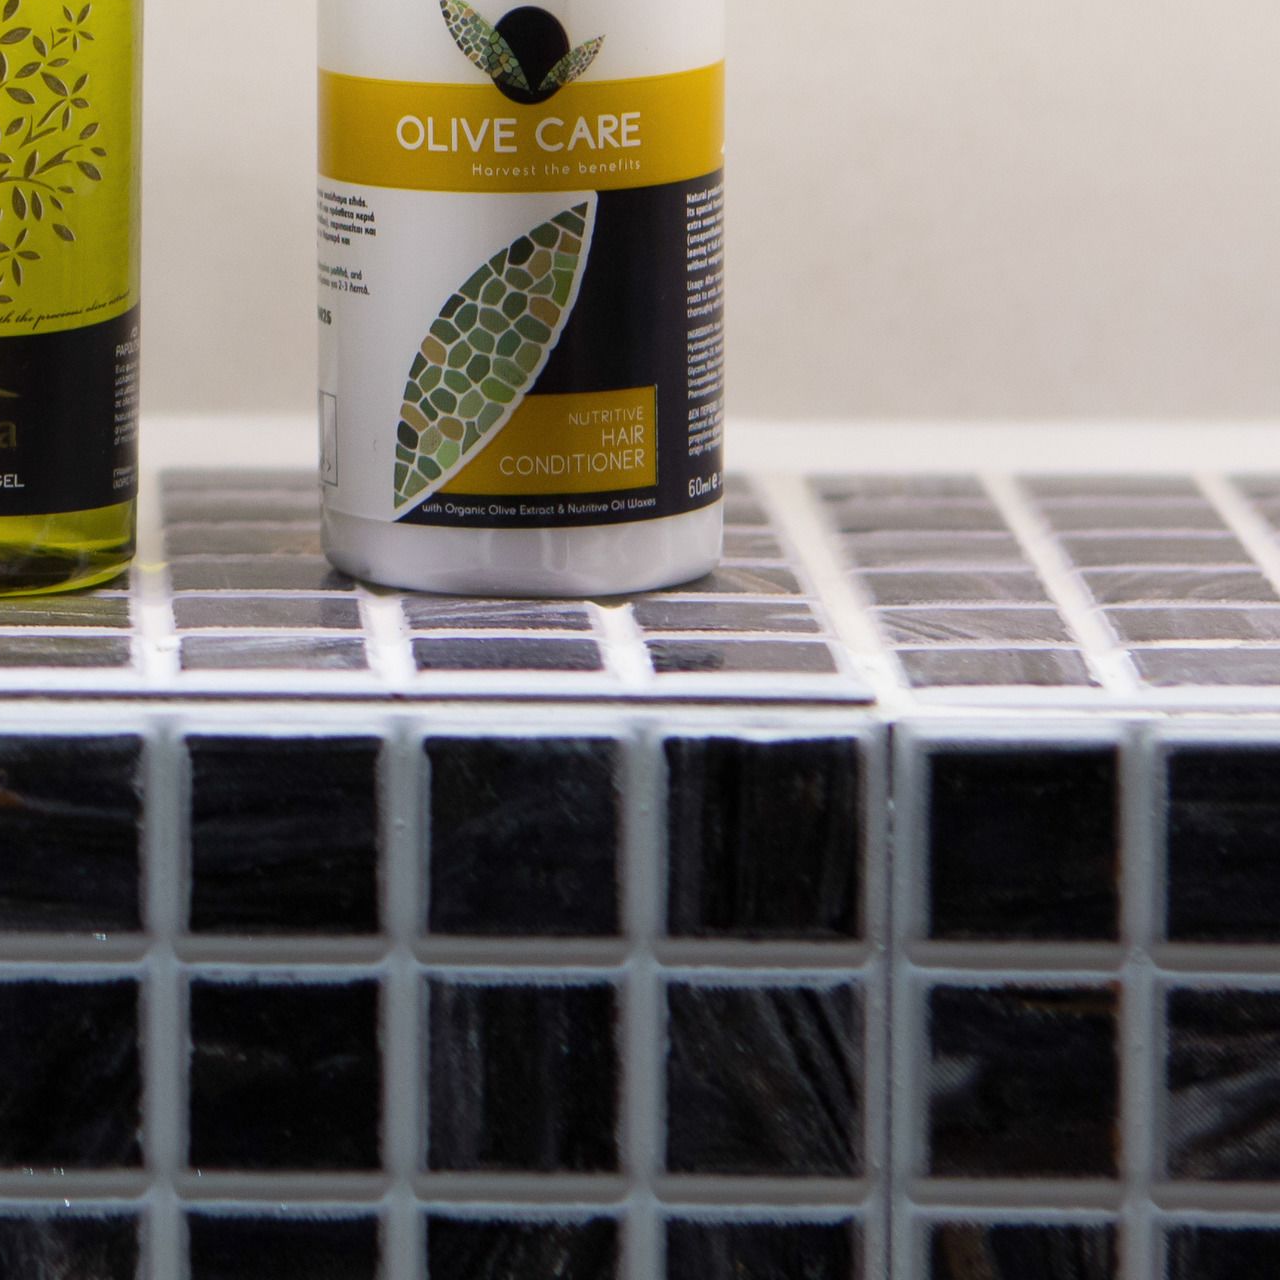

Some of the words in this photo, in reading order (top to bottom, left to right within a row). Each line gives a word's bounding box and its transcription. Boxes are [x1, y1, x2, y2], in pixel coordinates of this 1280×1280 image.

[396, 115, 517, 153] OLIVE
[535, 111, 641, 152] CARE
[472, 163, 536, 177] Harvest
[544, 163, 570, 175] the
[579, 158, 641, 175] benefits
[15, 308, 35, 323] the
[32, 308, 83, 330] precious
[568, 406, 644, 426] NUTRITIVE
[601, 424, 644, 447] HAIR
[500, 448, 645, 476] CONDITIONER
[688, 476, 711, 498] 60ml
[422, 503, 442, 513] with
[444, 503, 486, 517] Organic
[488, 504, 517, 515] Olive
[520, 504, 555, 515] Extract
[558, 504, 565, 514] &
[567, 503, 609, 514] Nutritive
[610, 499, 626, 511] Oil
[627, 497, 656, 510] Waxes
